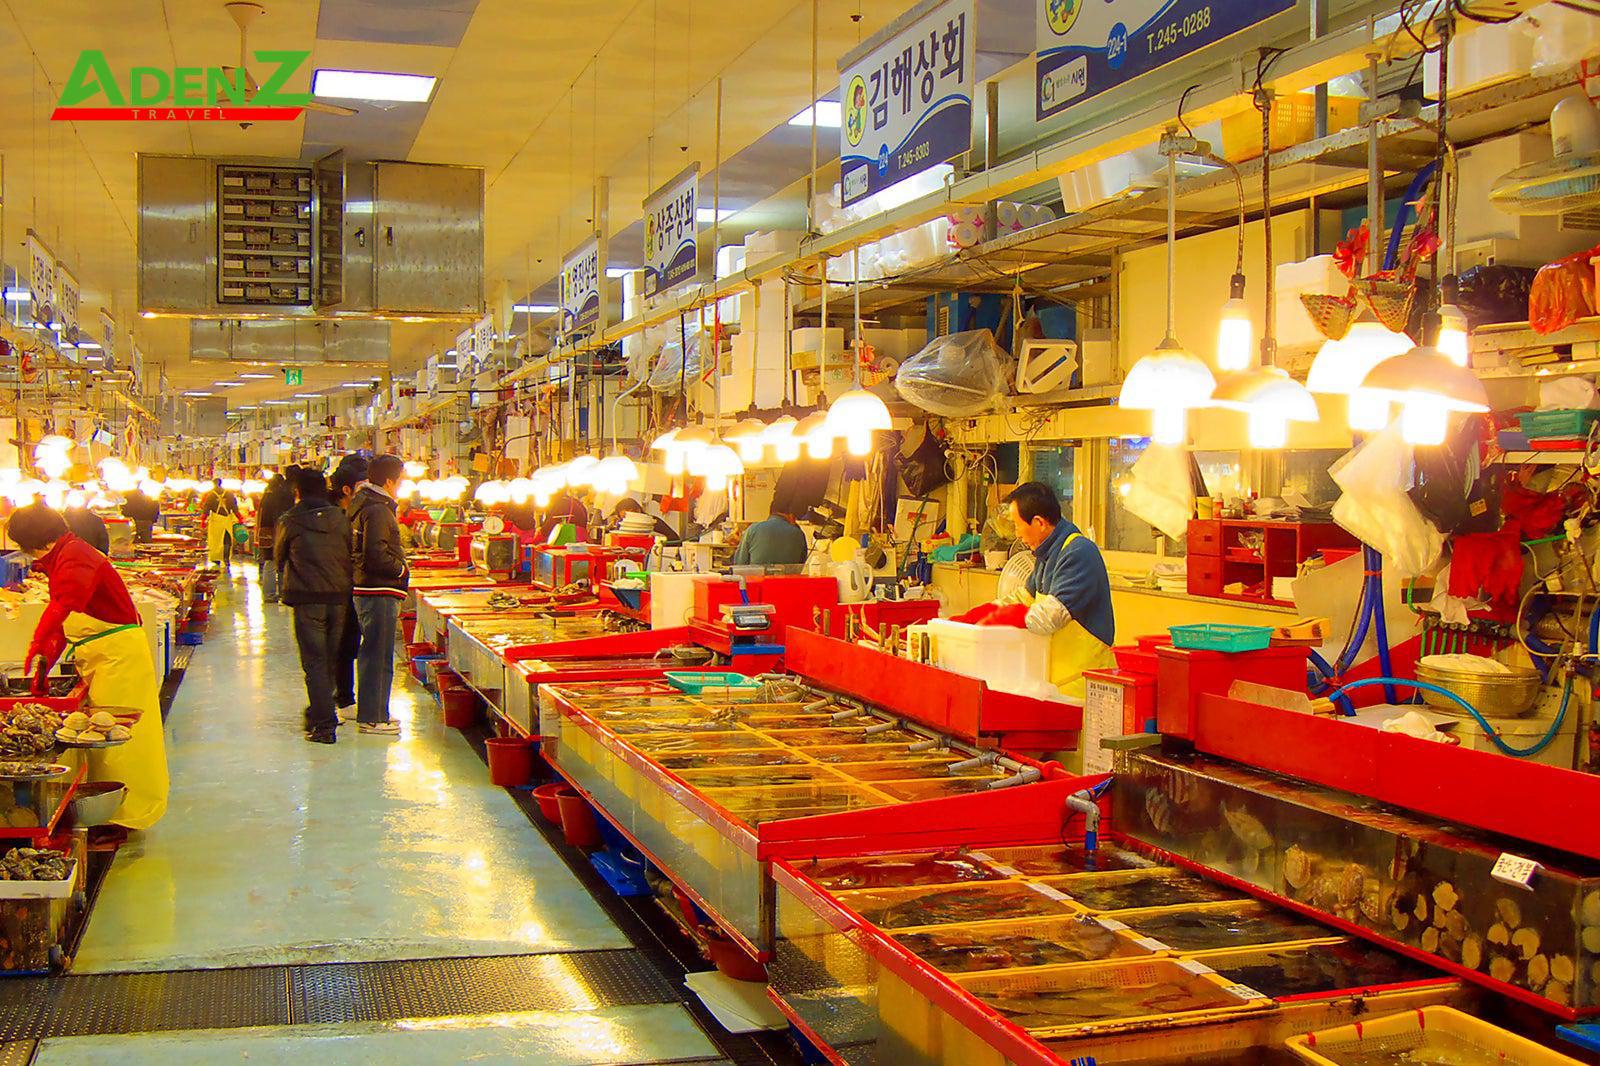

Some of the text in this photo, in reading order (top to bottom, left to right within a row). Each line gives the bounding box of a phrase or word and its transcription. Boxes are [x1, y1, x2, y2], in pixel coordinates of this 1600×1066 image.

[1107, 32, 1128, 60] 224-1
[1147, 6, 1211, 54] T.245-0288
[869, 12, 965, 131] 김해상회
[656, 187, 694, 251] 상주상회
